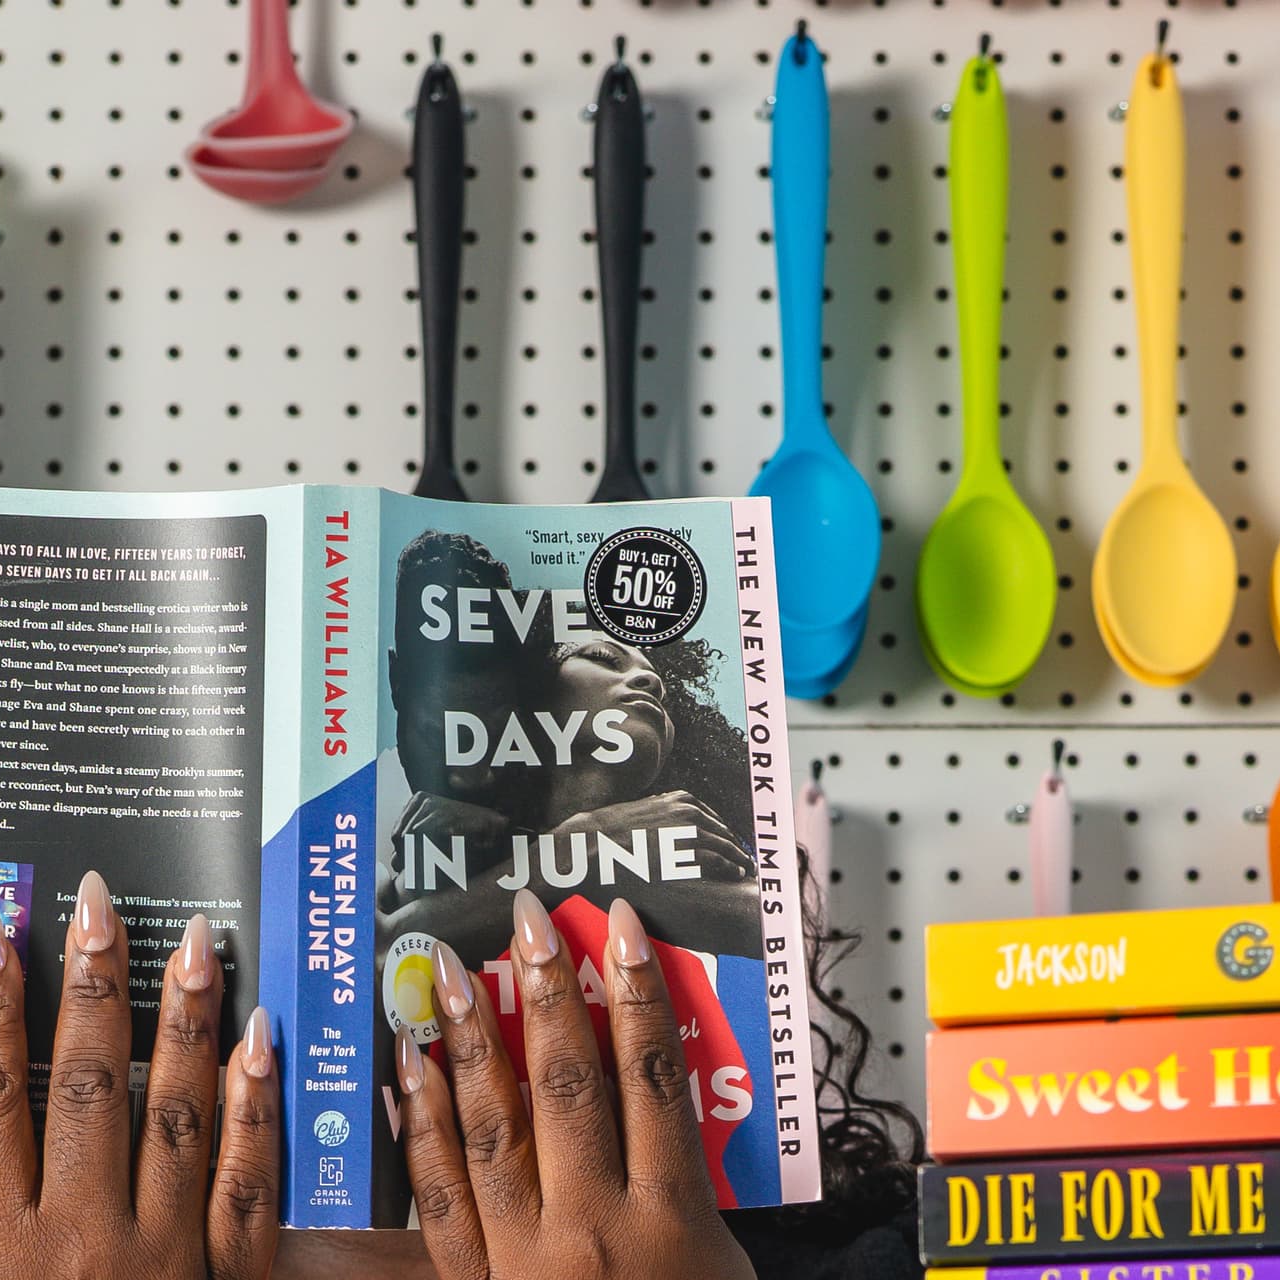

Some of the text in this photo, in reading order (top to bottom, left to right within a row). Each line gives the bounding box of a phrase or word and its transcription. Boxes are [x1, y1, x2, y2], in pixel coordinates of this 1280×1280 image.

[577, 531, 604, 546] sexy
[20, 544, 33, 556] TO
[36, 545, 62, 558] FALL
[65, 547, 77, 558] IN
[80, 547, 110, 560] LOVE,
[114, 548, 157, 560] FIFTEEN
[160, 548, 192, 560] YEARS
[195, 548, 207, 560] TO
[210, 546, 246, 559] FORGET,
[531, 550, 564, 566] loved
[619, 549, 677, 567] BUY 1, GET 1
[6, 565, 41, 577] SEVEN
[44, 566, 72, 579] DAYS
[75, 568, 89, 580] TO
[92, 568, 112, 580] GET
[115, 569, 126, 581] IT
[128, 569, 147, 581] ALL
[150, 569, 176, 581] BACK
[179, 569, 219, 581] AGAIN...
[613, 564, 676, 607] 50%
[0, 597, 9, 607] is
[10, 600, 17, 608] a
[19, 599, 50, 612] single
[51, 602, 78, 611] mom
[80, 601, 100, 612] and
[101, 602, 155, 615] bestselling
[156, 603, 190, 613] erotica
[192, 603, 220, 612] writer
[221, 602, 240, 611] who
[240, 601, 248, 611] is
[653, 595, 675, 609] OFF
[420, 584, 594, 644] SEVE
[625, 615, 656, 630] B&N
[324, 511, 349, 756] TIA WILLIAMS
[19, 740, 49, 750] since.
[445, 709, 634, 767] DAYS
[735, 526, 801, 1158] THE NEW YORK TIMES BESTSELLER
[405, 825, 702, 891] IN JUNE
[181, 900, 217, 909] newest
[218, 900, 242, 909] book
[308, 845, 331, 972] IN JUNE
[333, 814, 357, 1005] SEVEN DAYS
[139, 917, 162, 928] FOR
[996, 937, 1126, 990] JACKSON
[322, 1027, 341, 1039] The
[309, 1045, 356, 1058] New York
[317, 1061, 348, 1074] Times
[306, 1079, 358, 1092] Bestseller
[967, 1050, 1188, 1121] Sweet
[316, 1119, 348, 1140] Club
[314, 1189, 349, 1198] GRAND
[309, 1198, 353, 1206] CENTRAL
[946, 1173, 1036, 1248] DIE
[1060, 1166, 1162, 1243] FOR
[1189, 1163, 1266, 1236] ME
